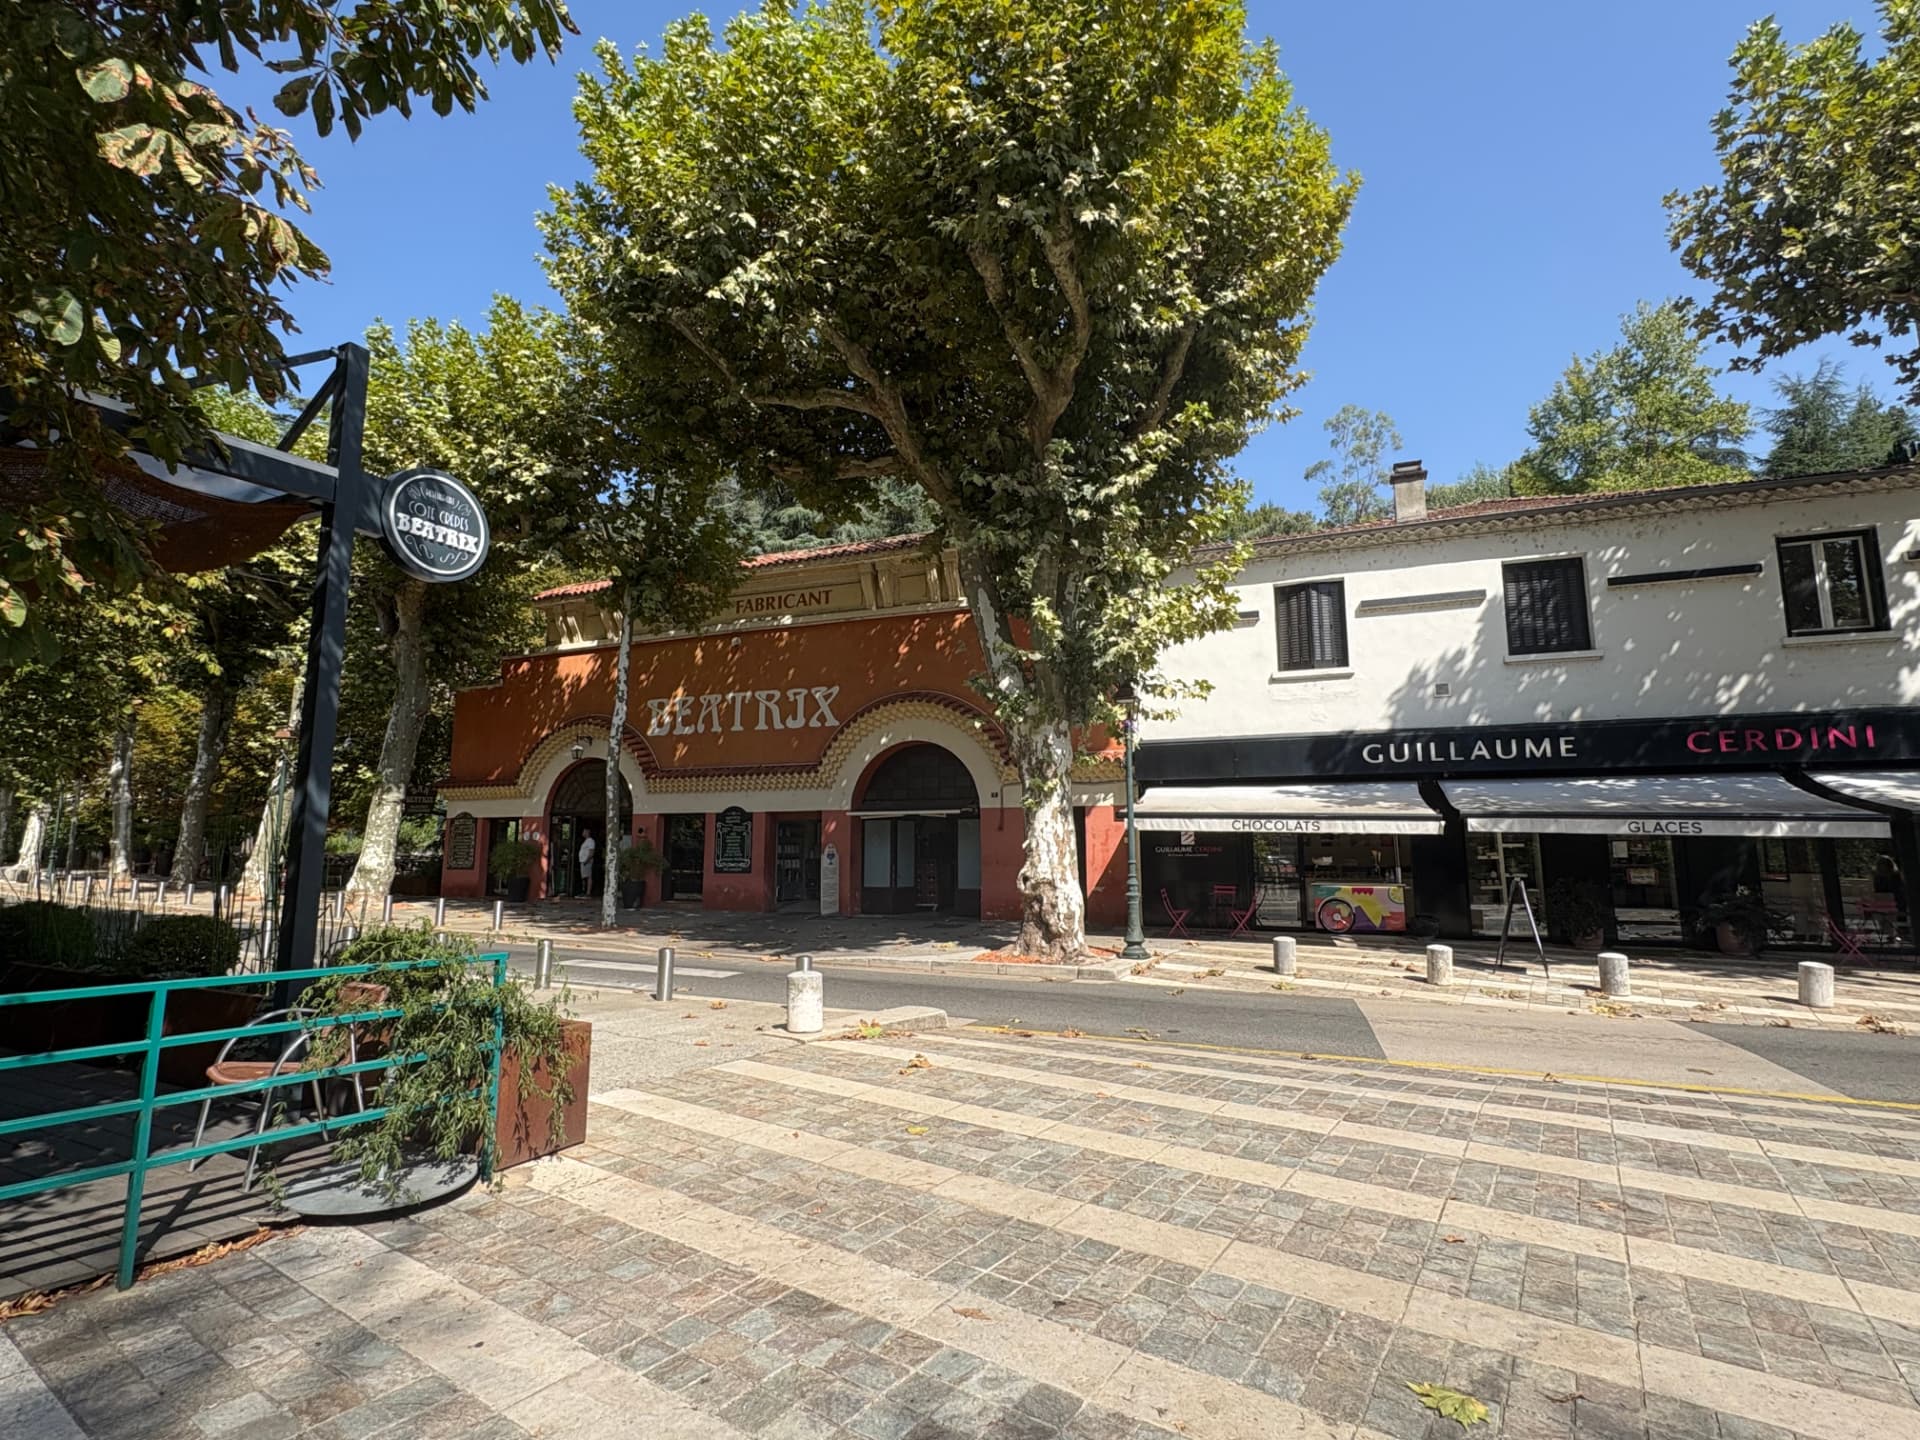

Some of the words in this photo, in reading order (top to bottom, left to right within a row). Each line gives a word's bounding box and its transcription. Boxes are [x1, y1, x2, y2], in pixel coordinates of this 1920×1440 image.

[396, 512, 479, 554] BEATRIX
[735, 589, 832, 614] FABRICANT
[646, 685, 840, 736] BEATRIX
[1362, 736, 1577, 764] GUILLAUME
[1686, 725, 1875, 753] CERDINI
[1231, 820, 1321, 831] CHOCOLATS
[1627, 821, 1703, 834] GLACES
